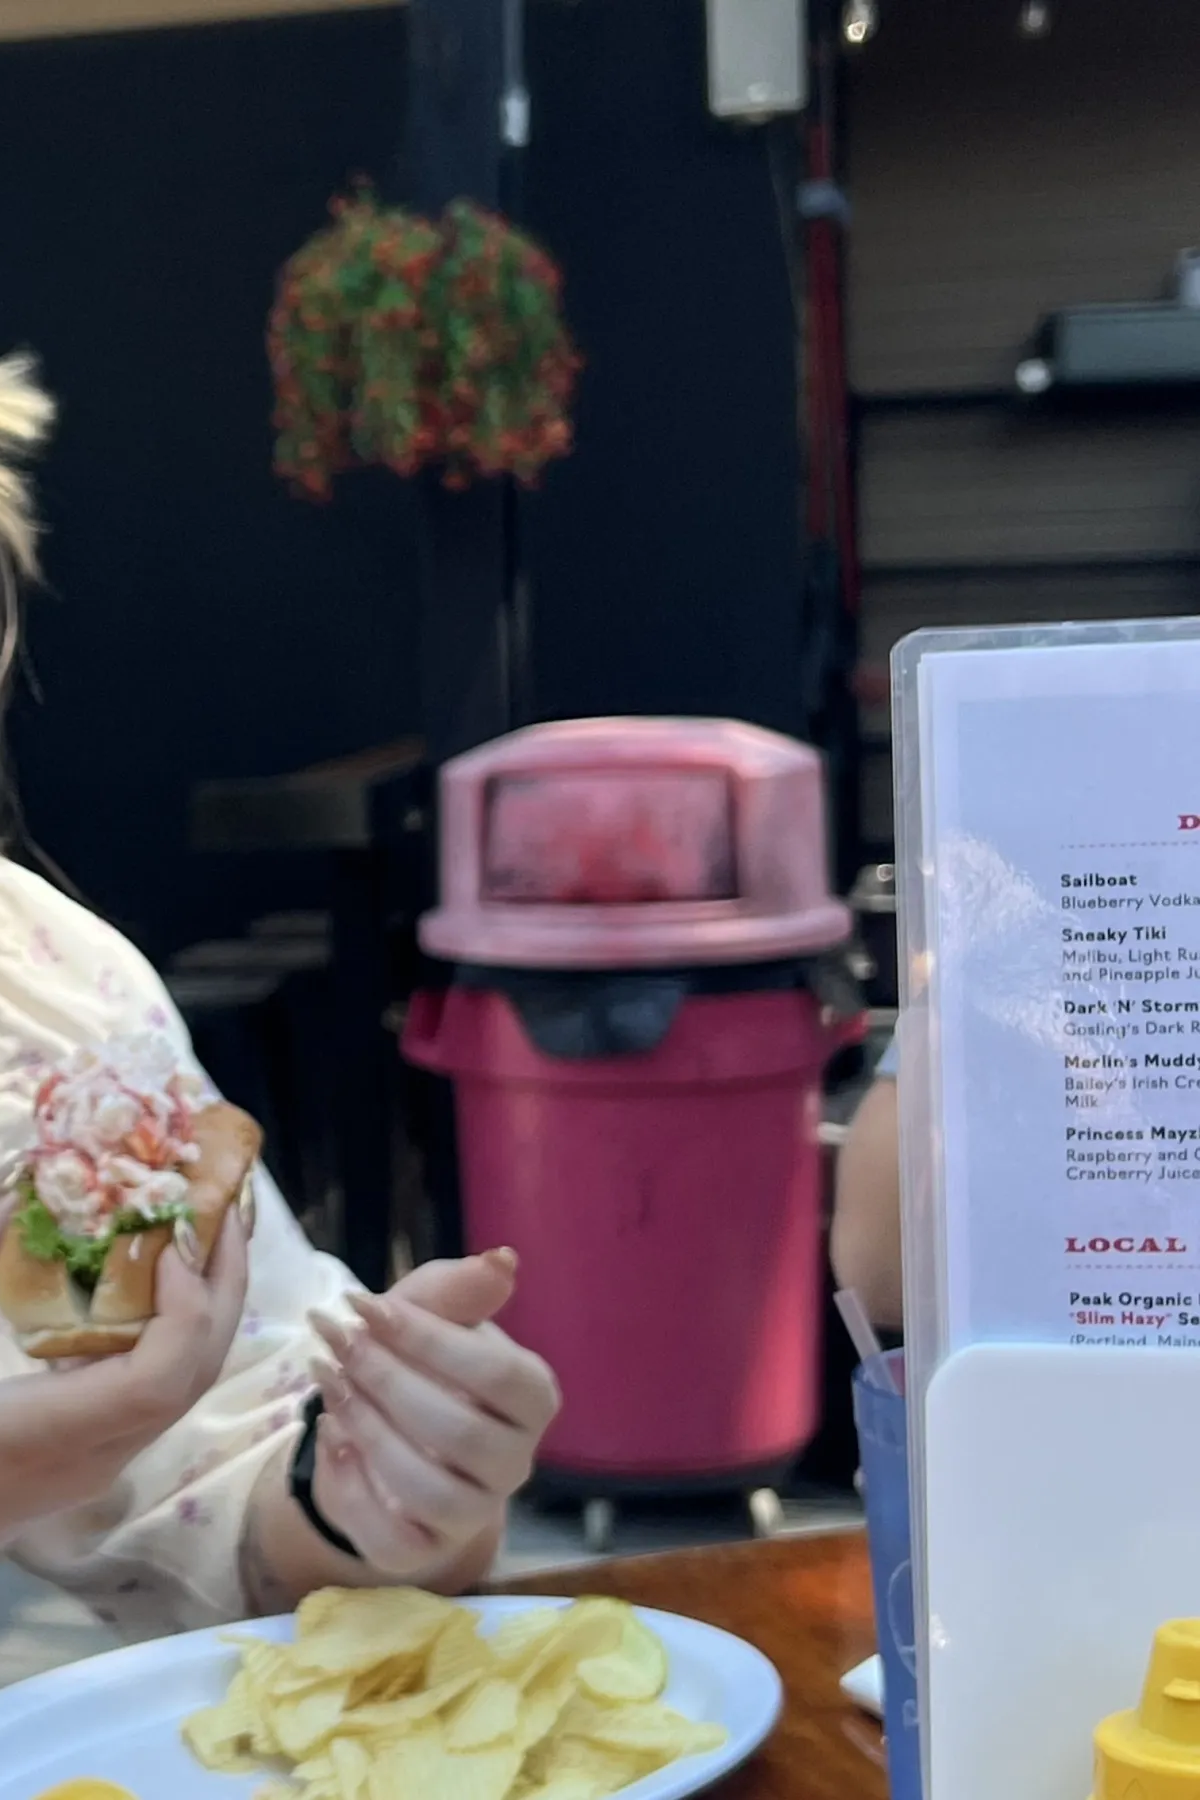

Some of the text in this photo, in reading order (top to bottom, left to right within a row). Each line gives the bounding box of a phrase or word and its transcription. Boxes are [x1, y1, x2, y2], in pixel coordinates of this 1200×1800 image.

[1177, 814, 1200, 830] D
[1061, 872, 1138, 888] Sailboat
[1061, 892, 1200, 912] Blueberry Vodka
[1062, 925, 1167, 946] Sneaky Tiki
[1062, 948, 1122, 964] Malibu,
[1128, 946, 1171, 966] Light
[1062, 966, 1093, 982] and
[1099, 965, 1180, 984] Pineapple
[1064, 999, 1107, 1015] Dark
[1142, 998, 1199, 1014] Storm
[1062, 1020, 1140, 1040] Gosling's
[1145, 1019, 1184, 1035] Dark
[1064, 1053, 1138, 1070] Merlin's
[1064, 1076, 1127, 1095] Bailey's
[1133, 1075, 1169, 1090] Irish
[1065, 1094, 1099, 1109] Milk
[1065, 1126, 1144, 1142] Princess
[1066, 1147, 1152, 1166] Raspberry
[1158, 1146, 1189, 1162] and
[1066, 1164, 1200, 1184] Cranberry Juice
[1064, 1236, 1187, 1254] LOCAL
[1070, 1291, 1112, 1307] Peak
[1118, 1290, 1193, 1310] Organic
